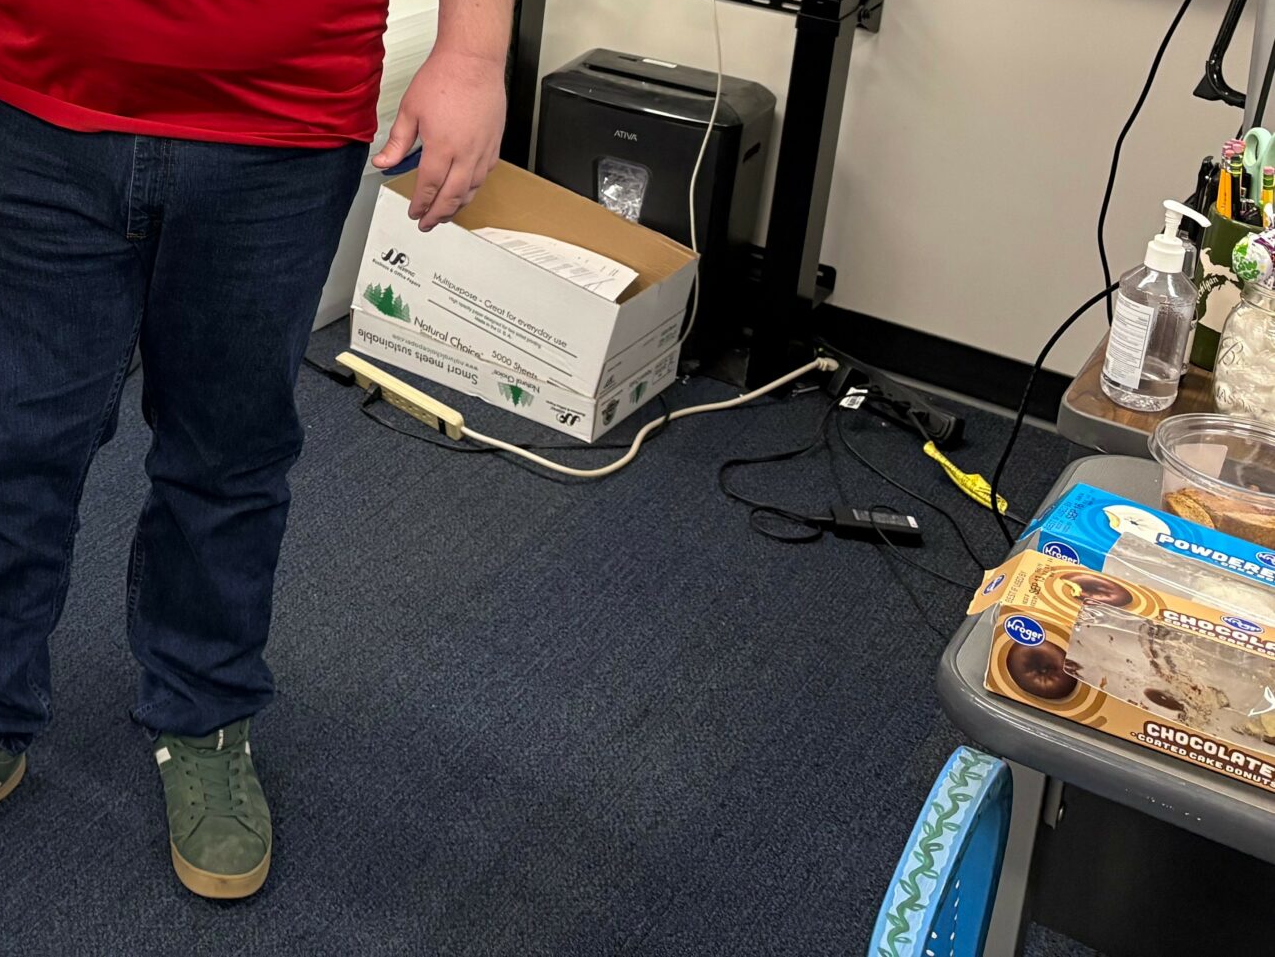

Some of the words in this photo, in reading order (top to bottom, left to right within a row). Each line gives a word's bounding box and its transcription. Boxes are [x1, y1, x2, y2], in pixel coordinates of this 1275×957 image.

[613, 130, 638, 142] ATIVA
[1196, 275, 1219, 304] ichigan
[433, 272, 477, 303] Multipurpose
[484, 299, 505, 316] Great
[506, 309, 517, 321] for
[518, 317, 553, 342] everyday
[554, 337, 568, 349] use
[358, 328, 414, 357] sustainable
[414, 317, 448, 342] Natural
[449, 335, 482, 359] Choice
[414, 351, 444, 369] meets
[491, 350, 513, 366] 5000
[513, 362, 538, 379] Sheets
[447, 364, 479, 386] Smart
[493, 369, 516, 384] Choice
[515, 377, 541, 394] Natural
[1044, 545, 1078, 565] Kroger
[1157, 534, 1275, 578] POWDERE
[1006, 619, 1043, 641] Kroger
[1162, 609, 1275, 651] CHOCOLA
[1137, 732, 1187, 757] COATED
[1189, 751, 1224, 770] CAKE
[1146, 723, 1275, 778] CHOCOLATE
